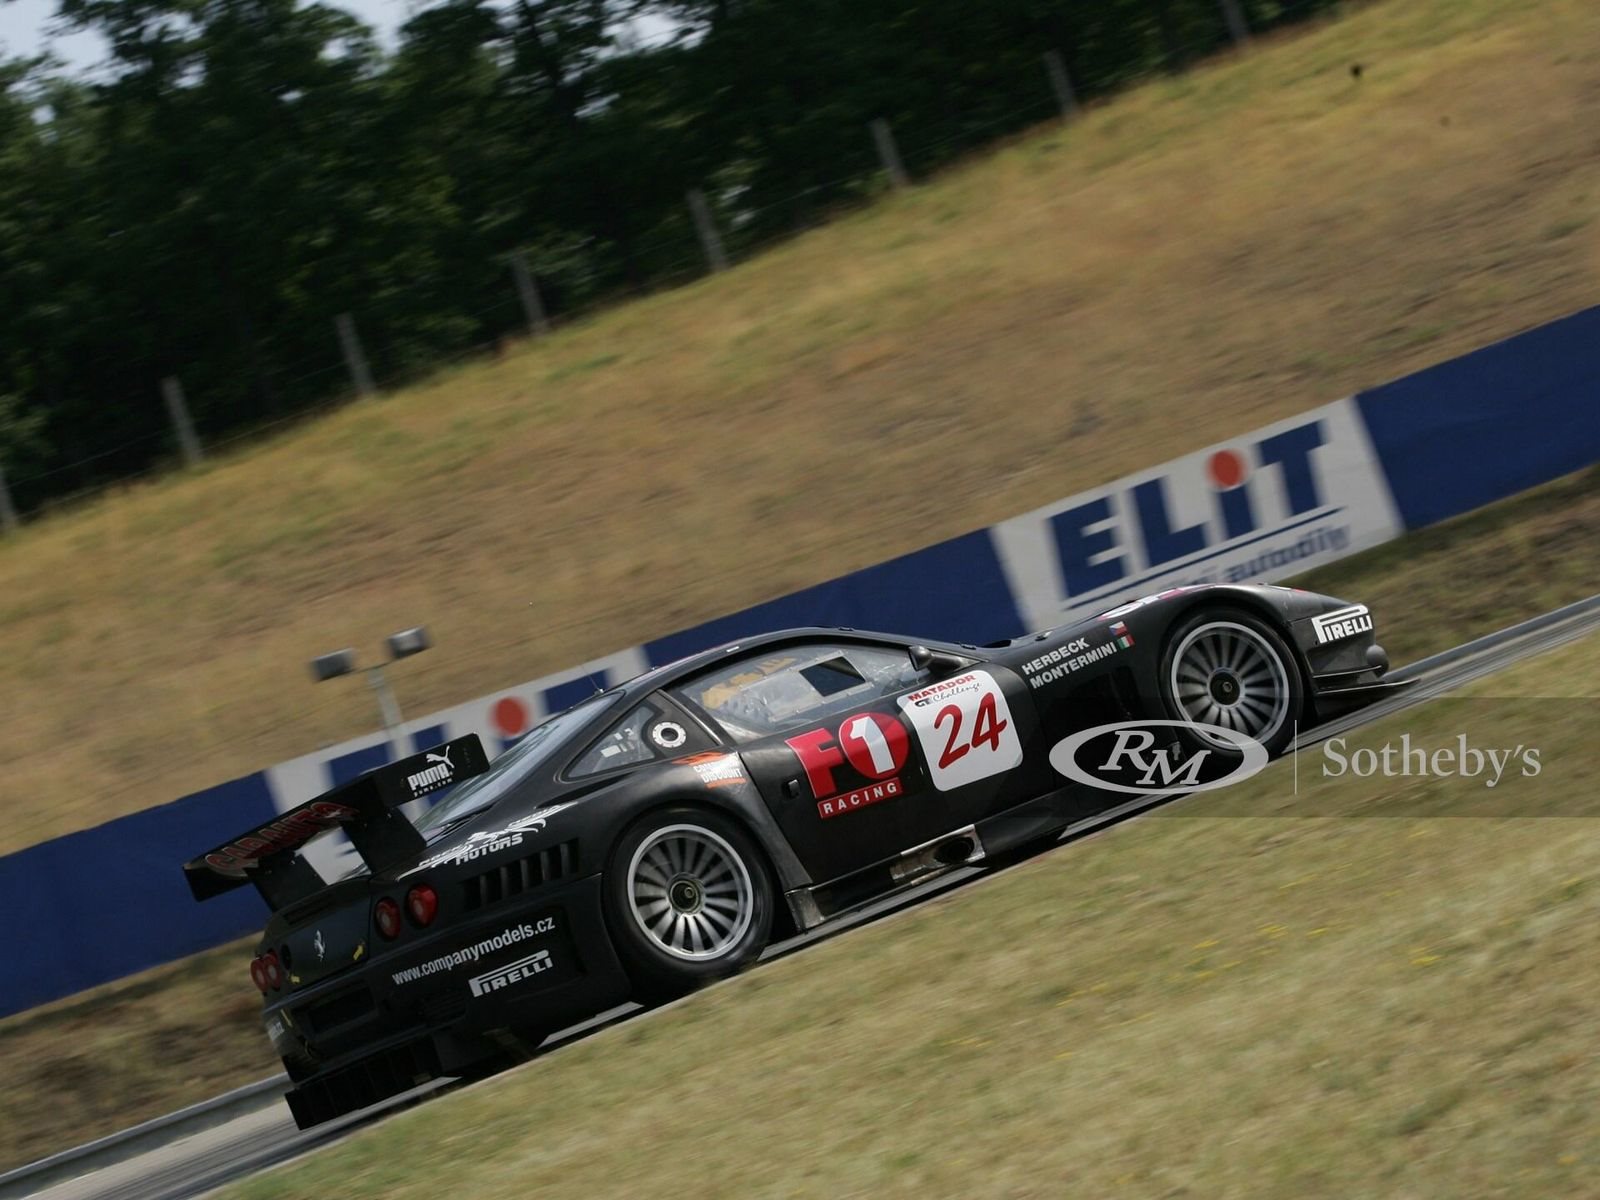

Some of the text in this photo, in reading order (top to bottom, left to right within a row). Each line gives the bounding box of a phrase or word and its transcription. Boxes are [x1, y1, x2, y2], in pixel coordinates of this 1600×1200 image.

[1311, 604, 1373, 644] PIRELLI
[1021, 637, 1090, 675] HERBECK
[1029, 641, 1118, 689] MONTERMINI
[907, 674, 977, 702] MATADOR
[914, 697, 932, 708] GT
[933, 691, 1008, 770] 24
[407, 762, 451, 791] PUMA
[822, 782, 897, 814] RACING
[455, 832, 524, 866] MOTORS
[391, 916, 556, 986] www.companymodels.cz
[468, 949, 554, 998] PIRELLI
